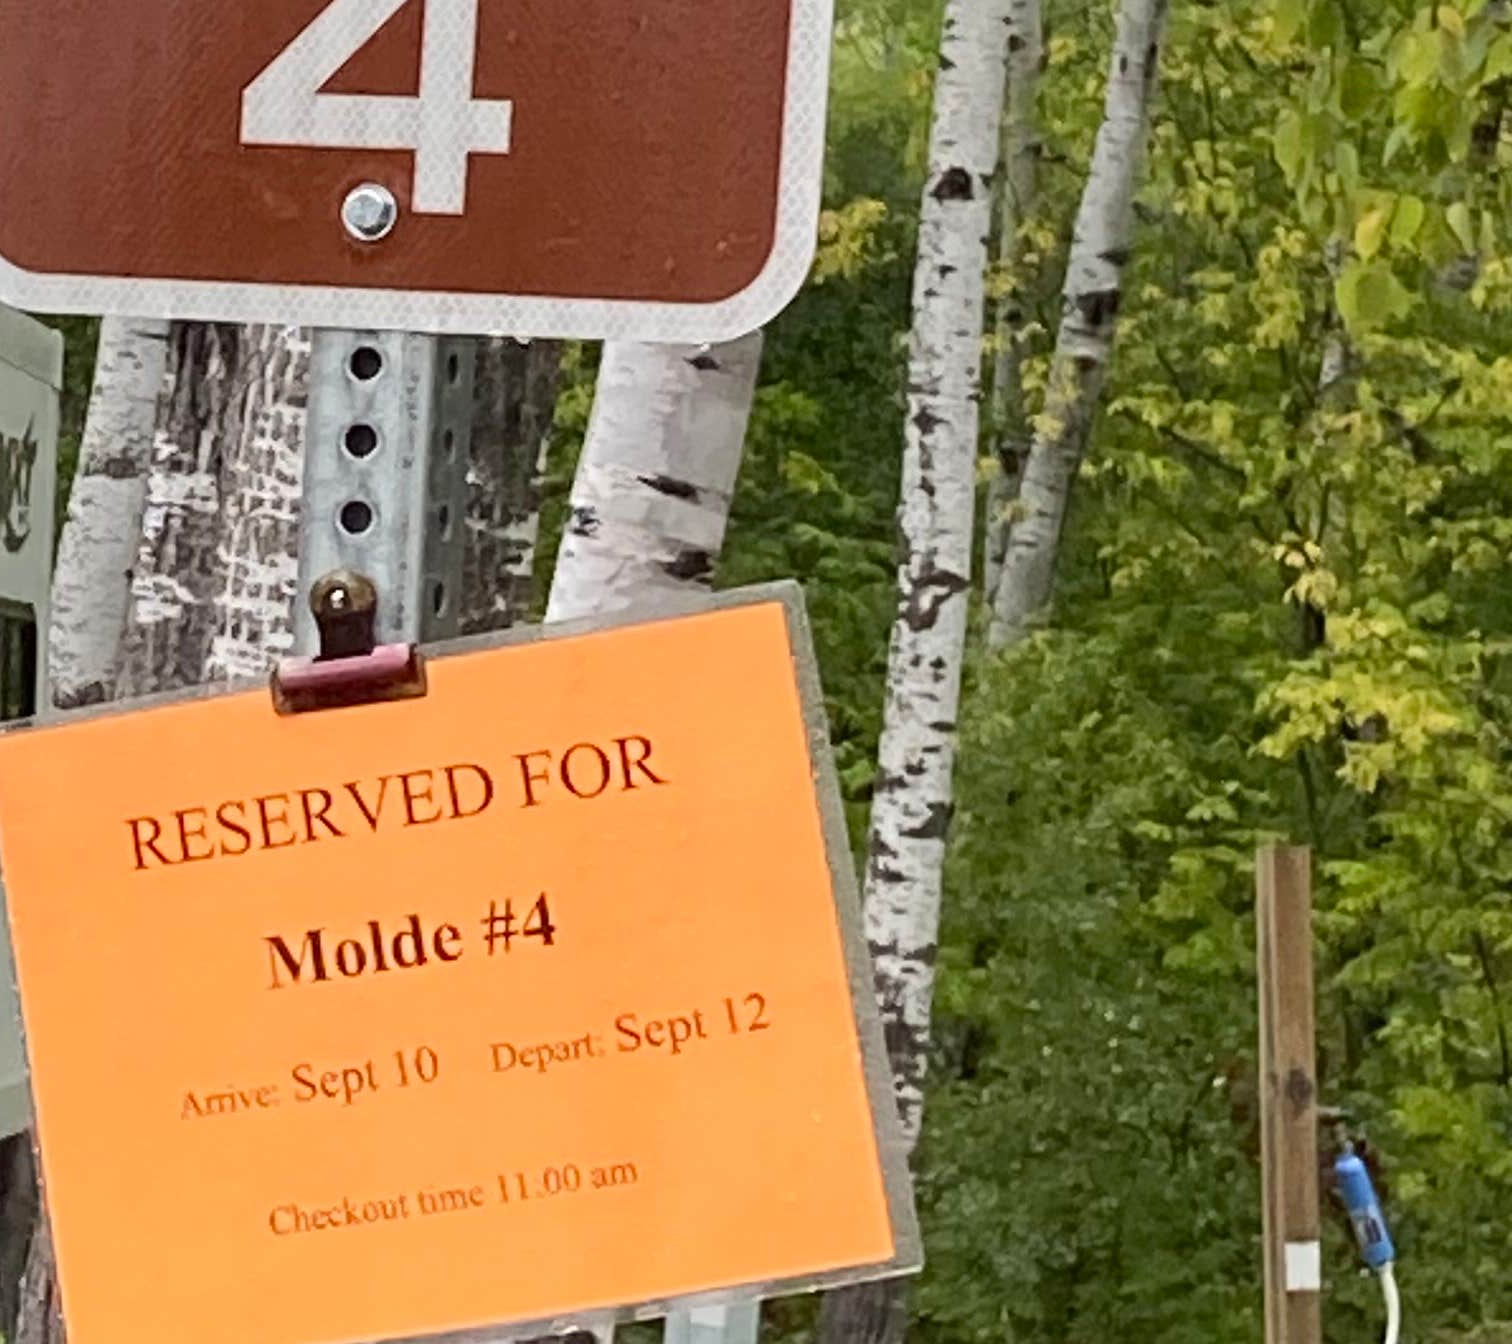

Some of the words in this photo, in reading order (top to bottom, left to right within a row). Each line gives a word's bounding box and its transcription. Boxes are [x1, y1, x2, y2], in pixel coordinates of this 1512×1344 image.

[125, 763, 494, 870] RESERVED
[516, 733, 668, 808] FOR
[263, 913, 464, 989] Molde
[480, 892, 557, 955] #4
[178, 1081, 282, 1120] Arrive:
[291, 1060, 380, 1106] Sept
[394, 1044, 439, 1086] 10
[490, 1031, 606, 1076] Depart:
[613, 1008, 708, 1059] Sept
[725, 991, 771, 1036] 12
[268, 1193, 410, 1236] Checkout
[416, 1181, 486, 1213] time
[589, 1160, 639, 1189] am
